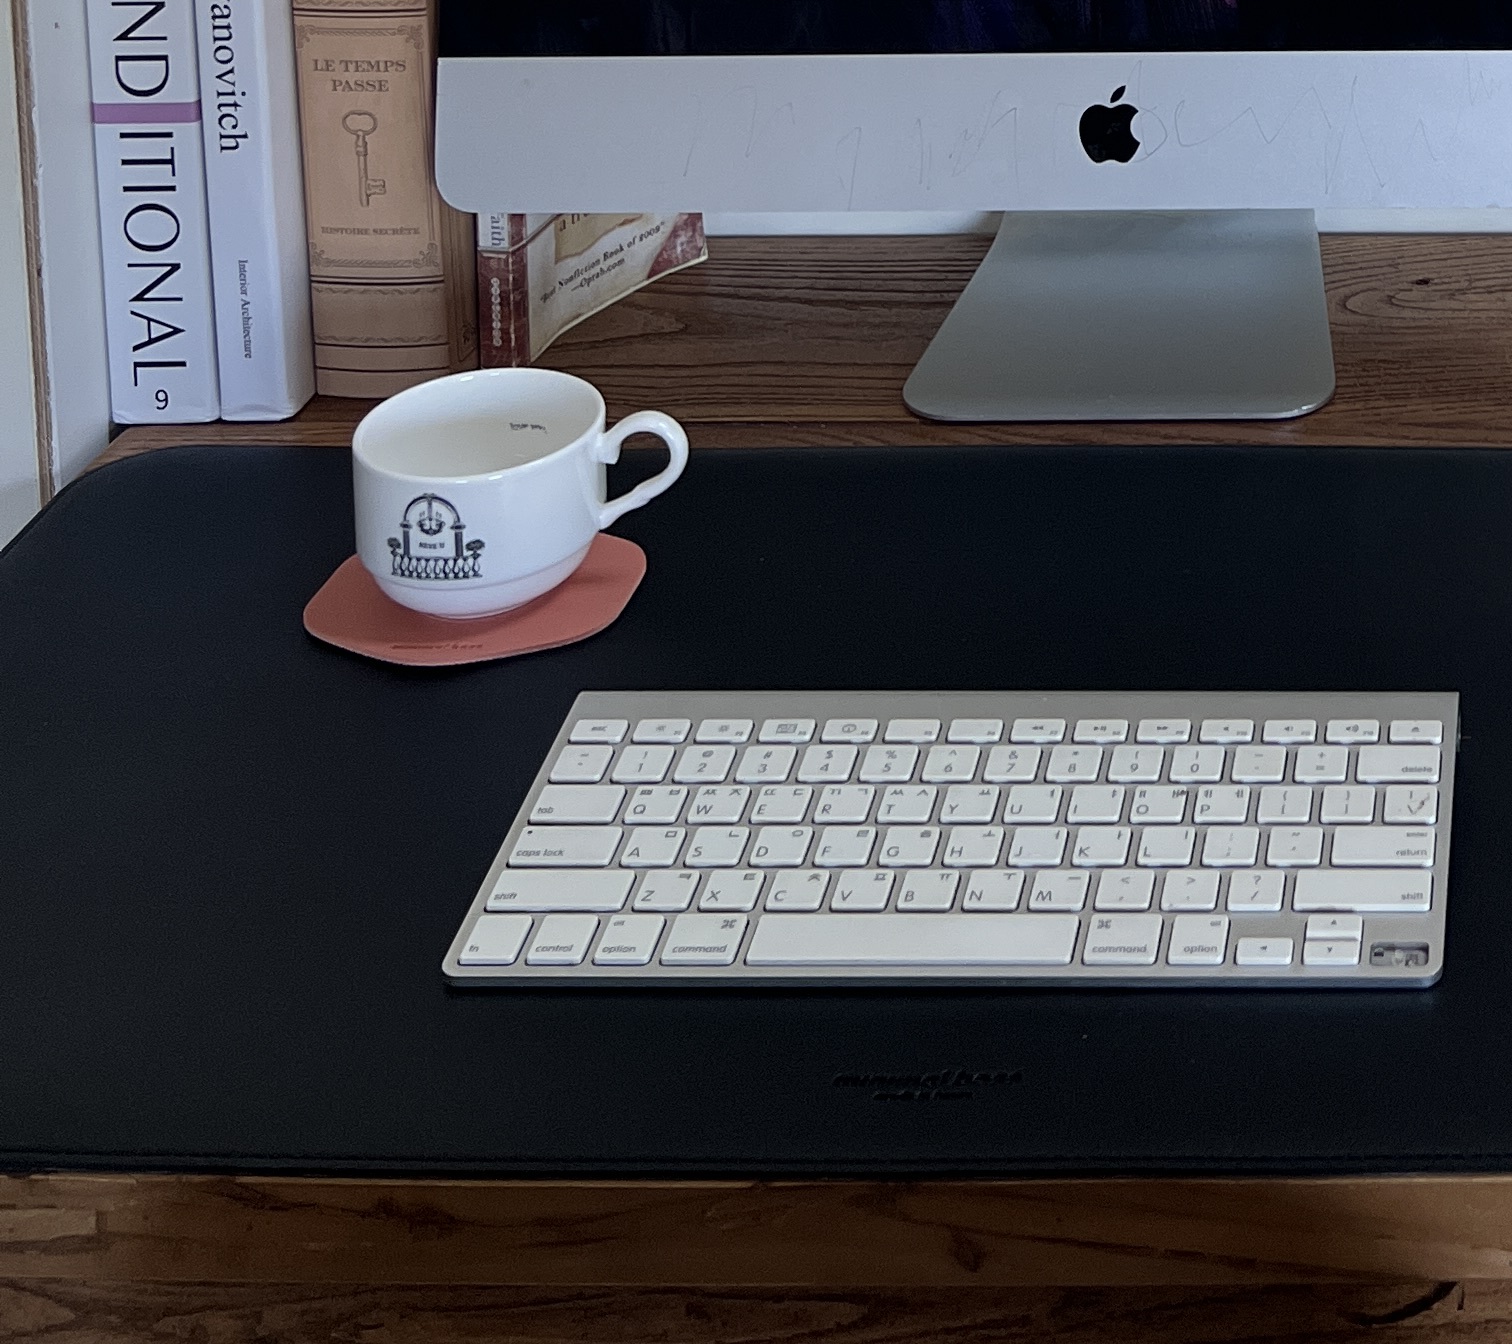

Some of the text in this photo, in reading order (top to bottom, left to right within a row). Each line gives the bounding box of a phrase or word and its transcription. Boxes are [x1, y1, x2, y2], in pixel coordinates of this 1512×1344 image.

[312, 57, 406, 73] LE TEMPS
[331, 78, 389, 93] PASSE
[558, 258, 600, 290] Nonfiction
[603, 243, 624, 261] Book
[627, 235, 637, 249] of
[238, 259, 252, 359] Interior Architecture
[154, 388, 170, 411] 9
[638, 763, 643, 772] 1
[697, 763, 707, 773] 2
[757, 764, 767, 774] 3
[820, 763, 829, 772] 4
[882, 763, 891, 773] 5
[944, 763, 953, 773] 6
[1006, 763, 1016, 773] 7
[1068, 763, 1076, 773] 8
[1130, 763, 1139, 773] 9
[1190, 763, 1199, 773] 0
[633, 804, 646, 815] Q
[696, 805, 713, 815] W
[757, 804, 766, 814] E
[821, 804, 831, 814] R
[886, 804, 895, 815] T
[949, 804, 959, 814] Y
[1010, 804, 1022, 815] U
[1072, 803, 1078, 814] I
[1135, 804, 1149, 815] O
[1200, 804, 1210, 815] P
[516, 849, 564, 858] caps lock
[627, 846, 640, 857] A
[692, 846, 702, 857] S
[756, 846, 768, 857] D
[821, 846, 831, 857] F
[886, 846, 899, 858] G
[949, 846, 963, 857] H
[1013, 846, 1023, 857] J
[1078, 847, 1090, 857] K
[1143, 846, 1151, 857] L
[493, 891, 517, 900] shift
[641, 890, 654, 902] Z
[707, 890, 720, 902] X
[775, 890, 786, 902] C
[841, 890, 852, 901] V
[904, 891, 914, 902] B
[968, 890, 983, 901] N
[1035, 890, 1052, 902] M
[1401, 892, 1423, 900] shift
[535, 944, 574, 953] control
[602, 944, 636, 954] option
[672, 945, 727, 953] command
[1092, 944, 1148, 954] command
[1183, 945, 1217, 954] option
